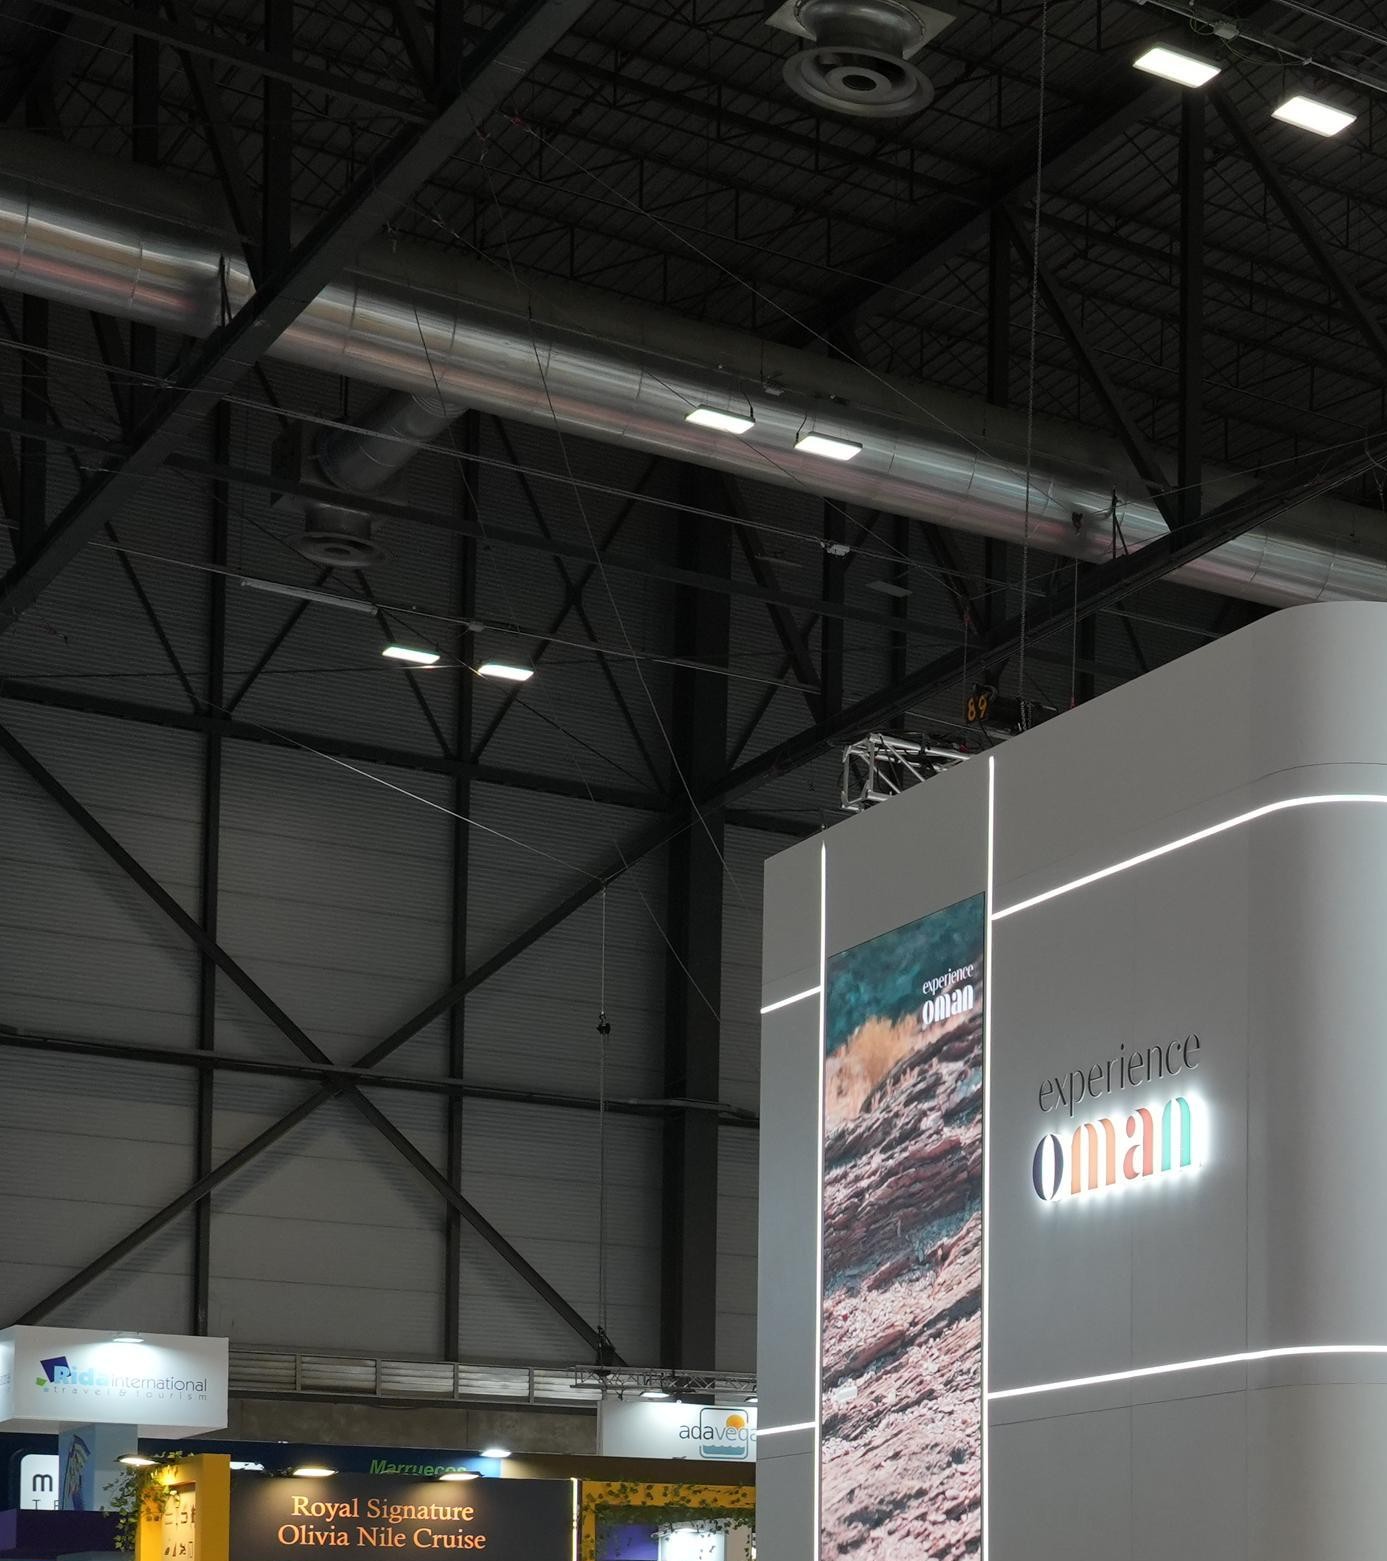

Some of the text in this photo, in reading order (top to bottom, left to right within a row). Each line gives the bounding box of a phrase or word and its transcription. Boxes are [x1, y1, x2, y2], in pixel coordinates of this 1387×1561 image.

[967, 695, 987, 721] 89
[923, 964, 973, 995] experience
[923, 985, 973, 1025] oman
[1039, 1033, 1200, 1119] experience
[1032, 1096, 1200, 1202] oman
[111, 1373, 207, 1392] international
[136, 1388, 207, 1400] tourism
[291, 1495, 475, 1524] Royal Signature
[278, 1524, 487, 1550] Olivia Nile Cruise
